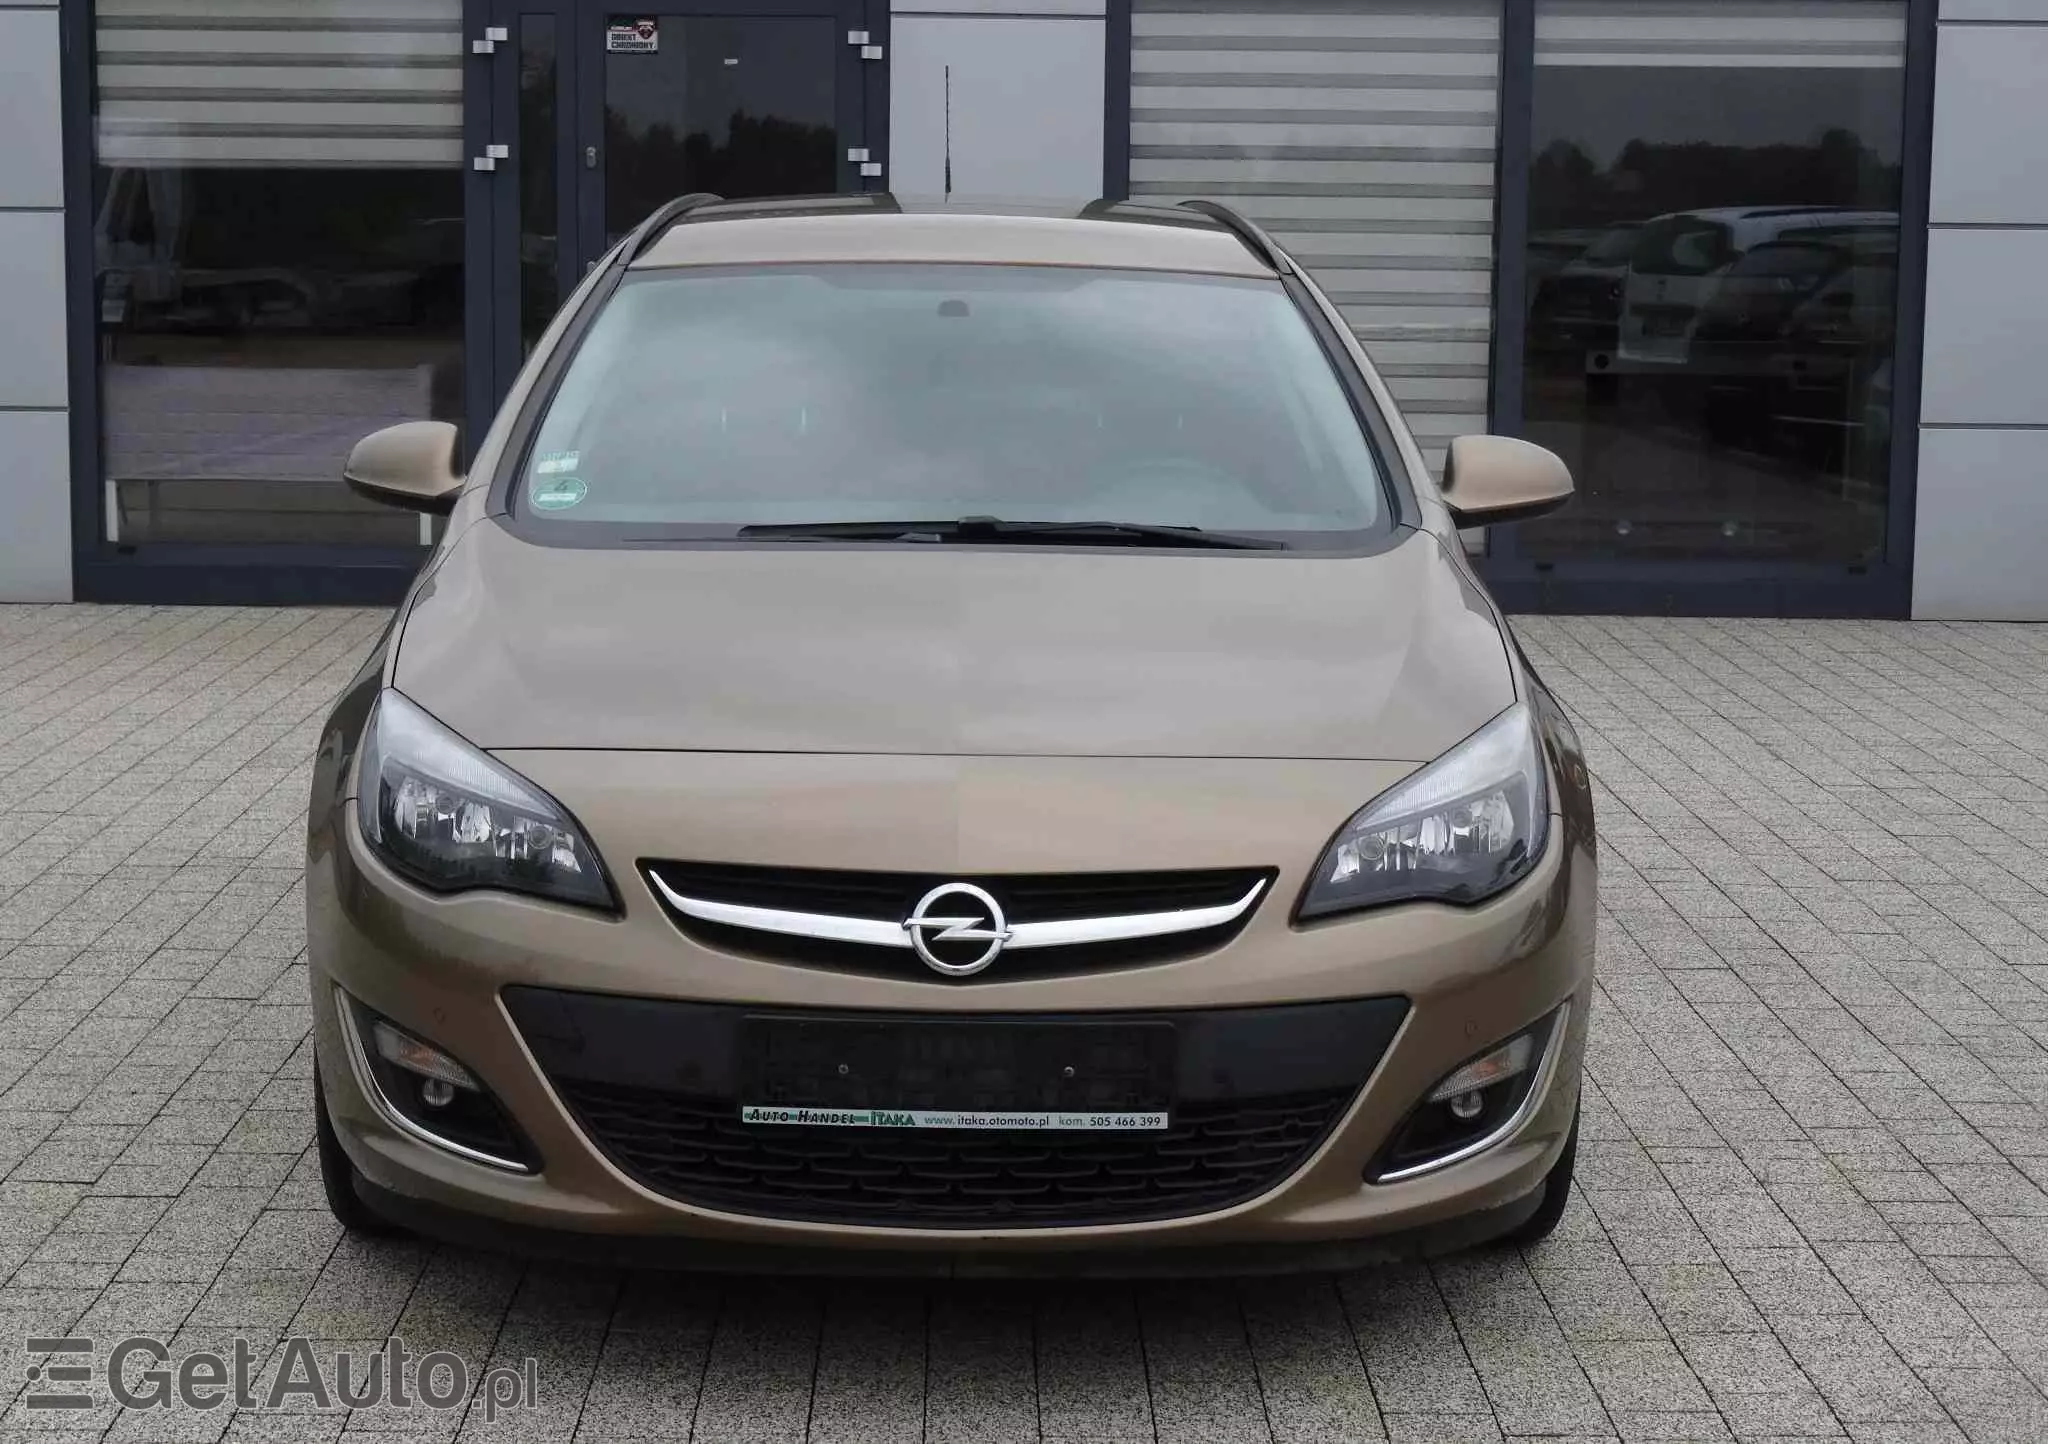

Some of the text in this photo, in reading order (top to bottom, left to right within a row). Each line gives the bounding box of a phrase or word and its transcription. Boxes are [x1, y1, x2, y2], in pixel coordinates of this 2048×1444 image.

[749, 1109, 789, 1122] AUTO
[797, 1109, 855, 1124] HANDEL
[870, 1110, 916, 1126] ITAKA
[1089, 1116, 1111, 1127] 505
[1114, 1116, 1136, 1127] 466
[1140, 1116, 1161, 1127] 399
